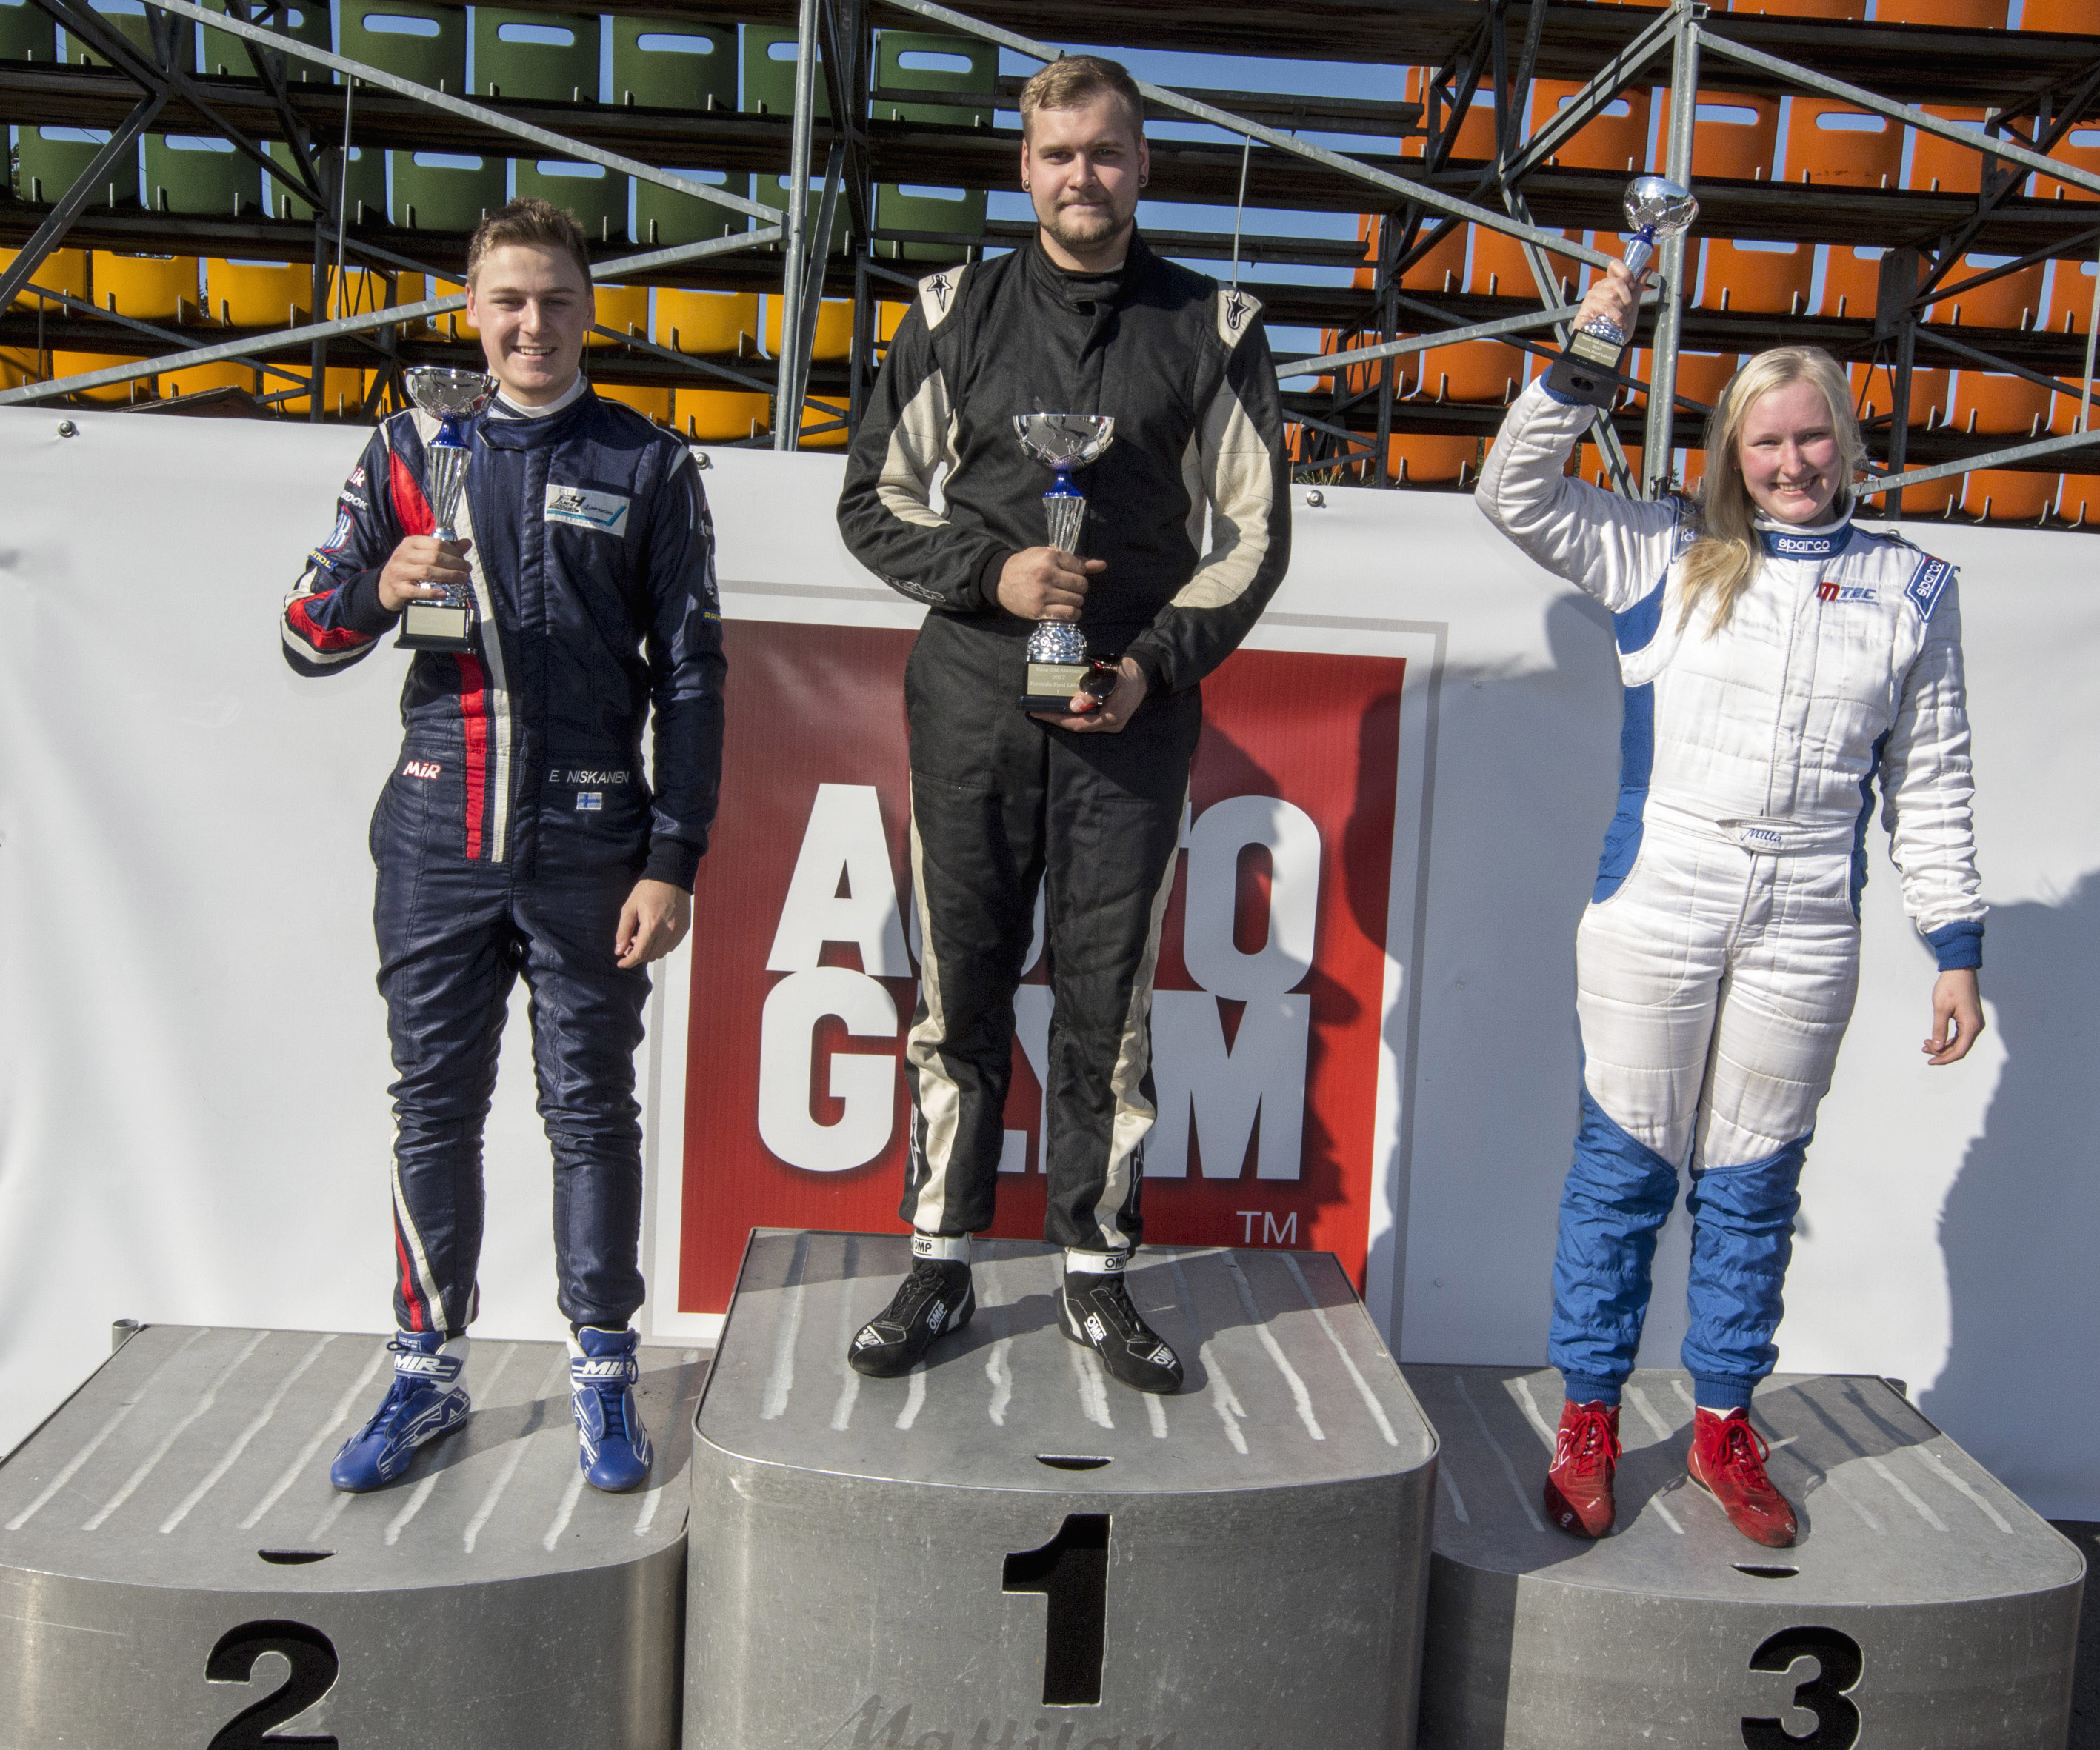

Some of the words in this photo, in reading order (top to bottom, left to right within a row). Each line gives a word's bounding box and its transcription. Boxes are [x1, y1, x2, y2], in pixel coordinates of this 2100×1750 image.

[348, 467, 366, 488] iR
[1778, 538, 1830, 553] sparco
[1916, 560, 1942, 596] sparco
[402, 761, 441, 779] MiR
[566, 770, 630, 784] NISKANEN
[1740, 828, 1781, 844] Milla
[766, 783, 1321, 1002] AO
[757, 966, 1311, 1180] GM
[1236, 1210, 1298, 1244] TM
[928, 1303, 945, 1330] OMP
[1087, 1315, 1104, 1342] OMP
[394, 1354, 441, 1372] MIR
[1002, 1513, 1112, 1706] 1
[204, 1618, 340, 1750] 2
[1741, 1626, 1865, 1750] 3
